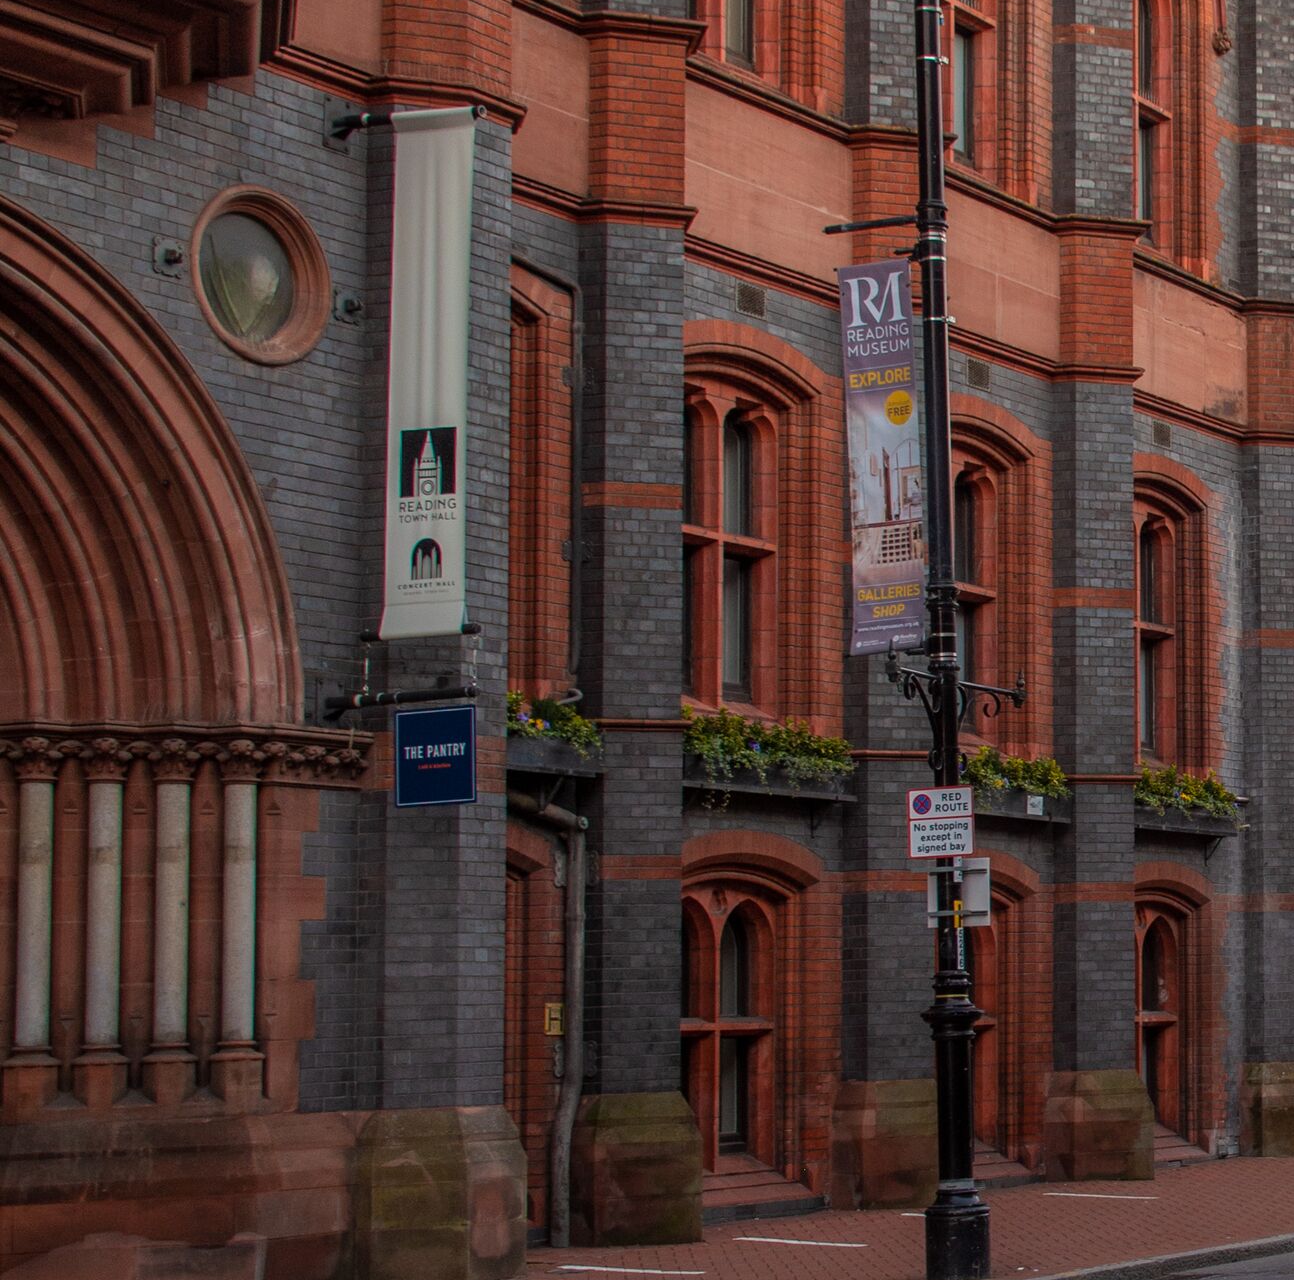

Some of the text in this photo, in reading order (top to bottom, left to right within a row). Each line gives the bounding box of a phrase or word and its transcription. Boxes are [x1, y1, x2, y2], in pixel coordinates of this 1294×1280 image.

[847, 322, 909, 342] READING
[847, 339, 910, 358] MUSEUM
[849, 367, 912, 388] EXPLORE
[888, 405, 911, 418] FREE
[399, 498, 456, 512] READING
[399, 512, 456, 523] TOWN HALL
[397, 582, 433, 590] CONCERT
[857, 584, 920, 602] GALLERIES
[872, 603, 905, 618] SHOP
[404, 742, 466, 760] THE PANTRY
[942, 793, 961, 801] RED
[935, 802, 969, 812] ROUTE
[913, 821, 968, 832] No stopping
[920, 832, 962, 842] except in
[917, 842, 966, 853] signed bay
